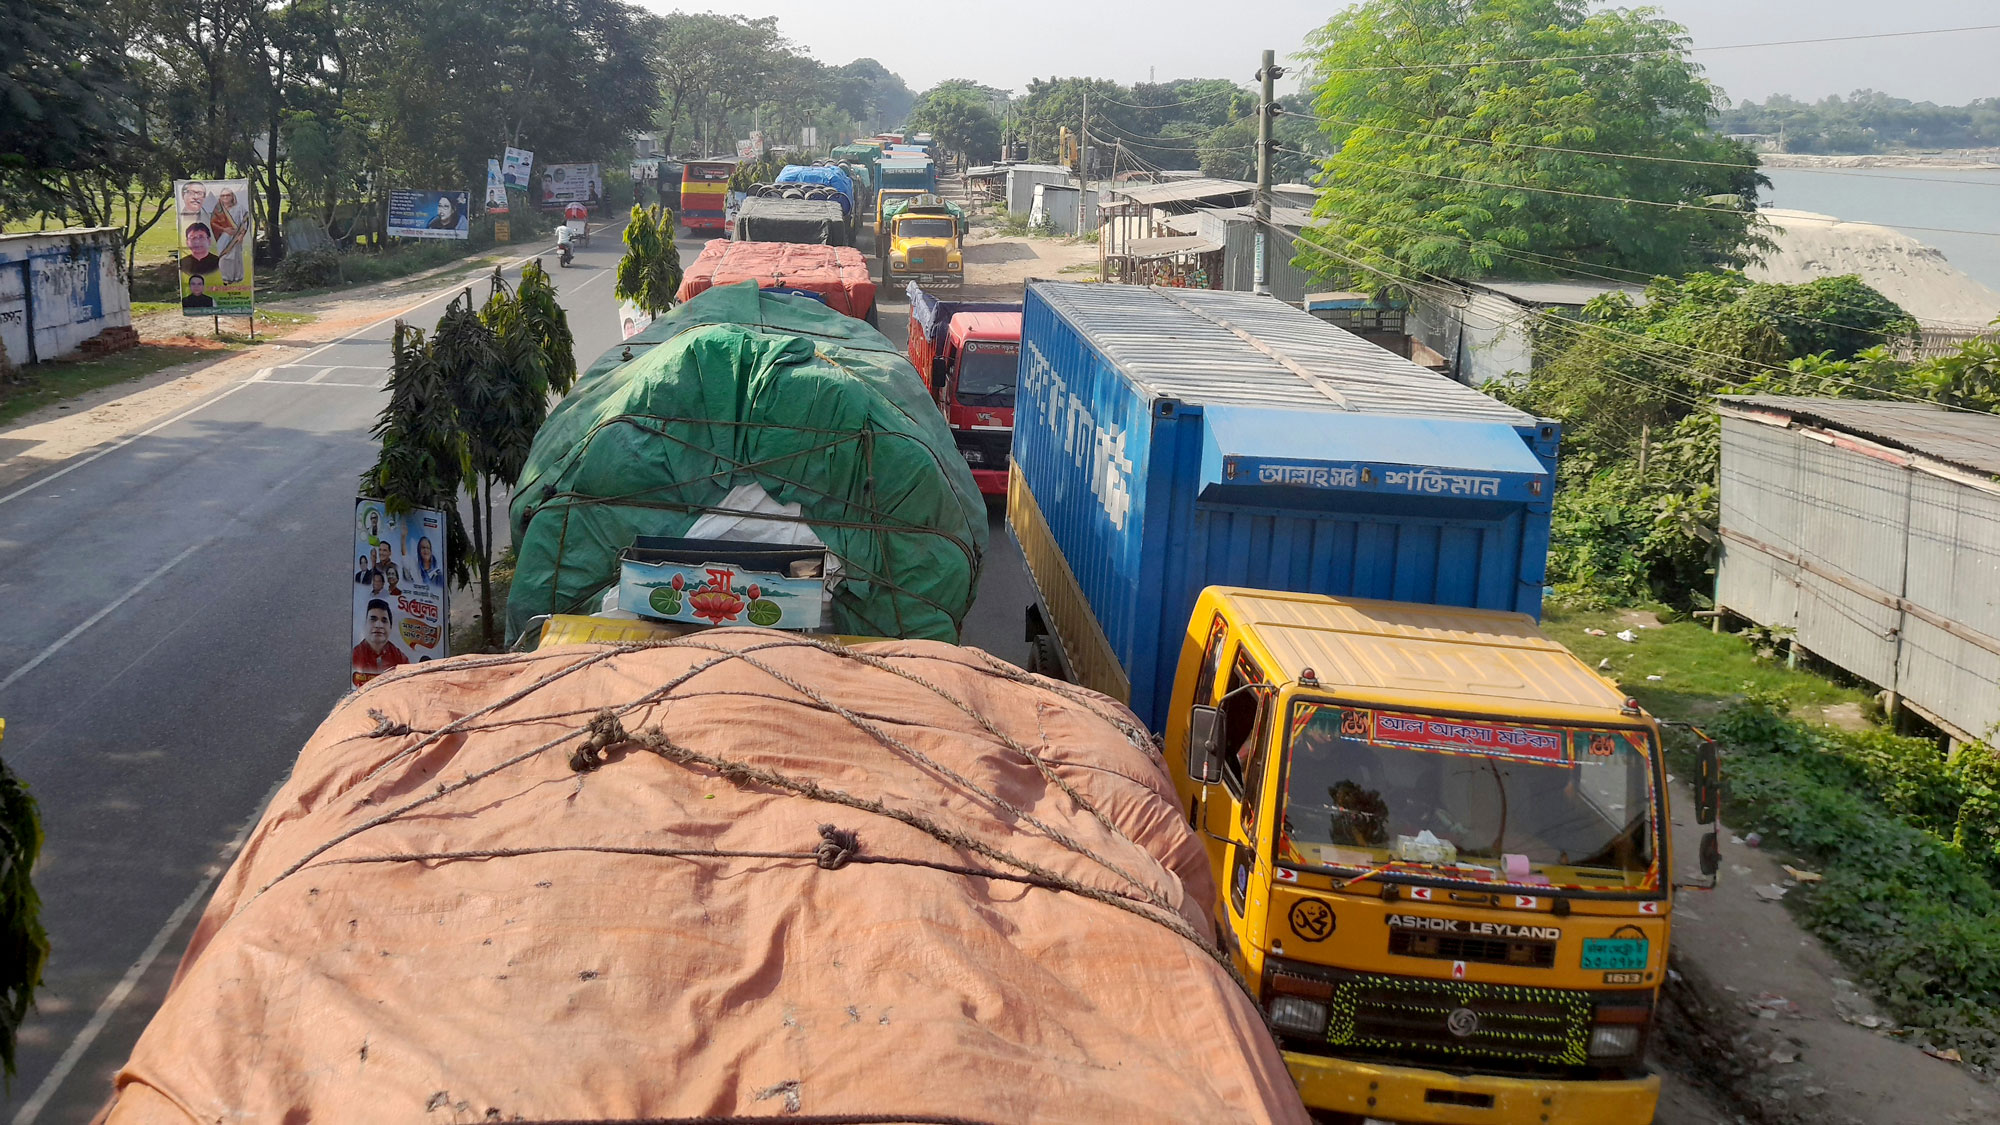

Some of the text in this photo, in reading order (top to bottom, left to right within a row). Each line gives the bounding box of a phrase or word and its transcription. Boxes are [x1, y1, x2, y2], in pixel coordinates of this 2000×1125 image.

[1386, 468, 1501, 496] শক্তিমান
[706, 568, 735, 592] মা
[398, 595, 439, 619] সম্মেলন
[1379, 716, 1425, 734] আল
[1388, 914, 1560, 939] ASHOK LEYLAND
[1607, 973, 1641, 983] 1613
